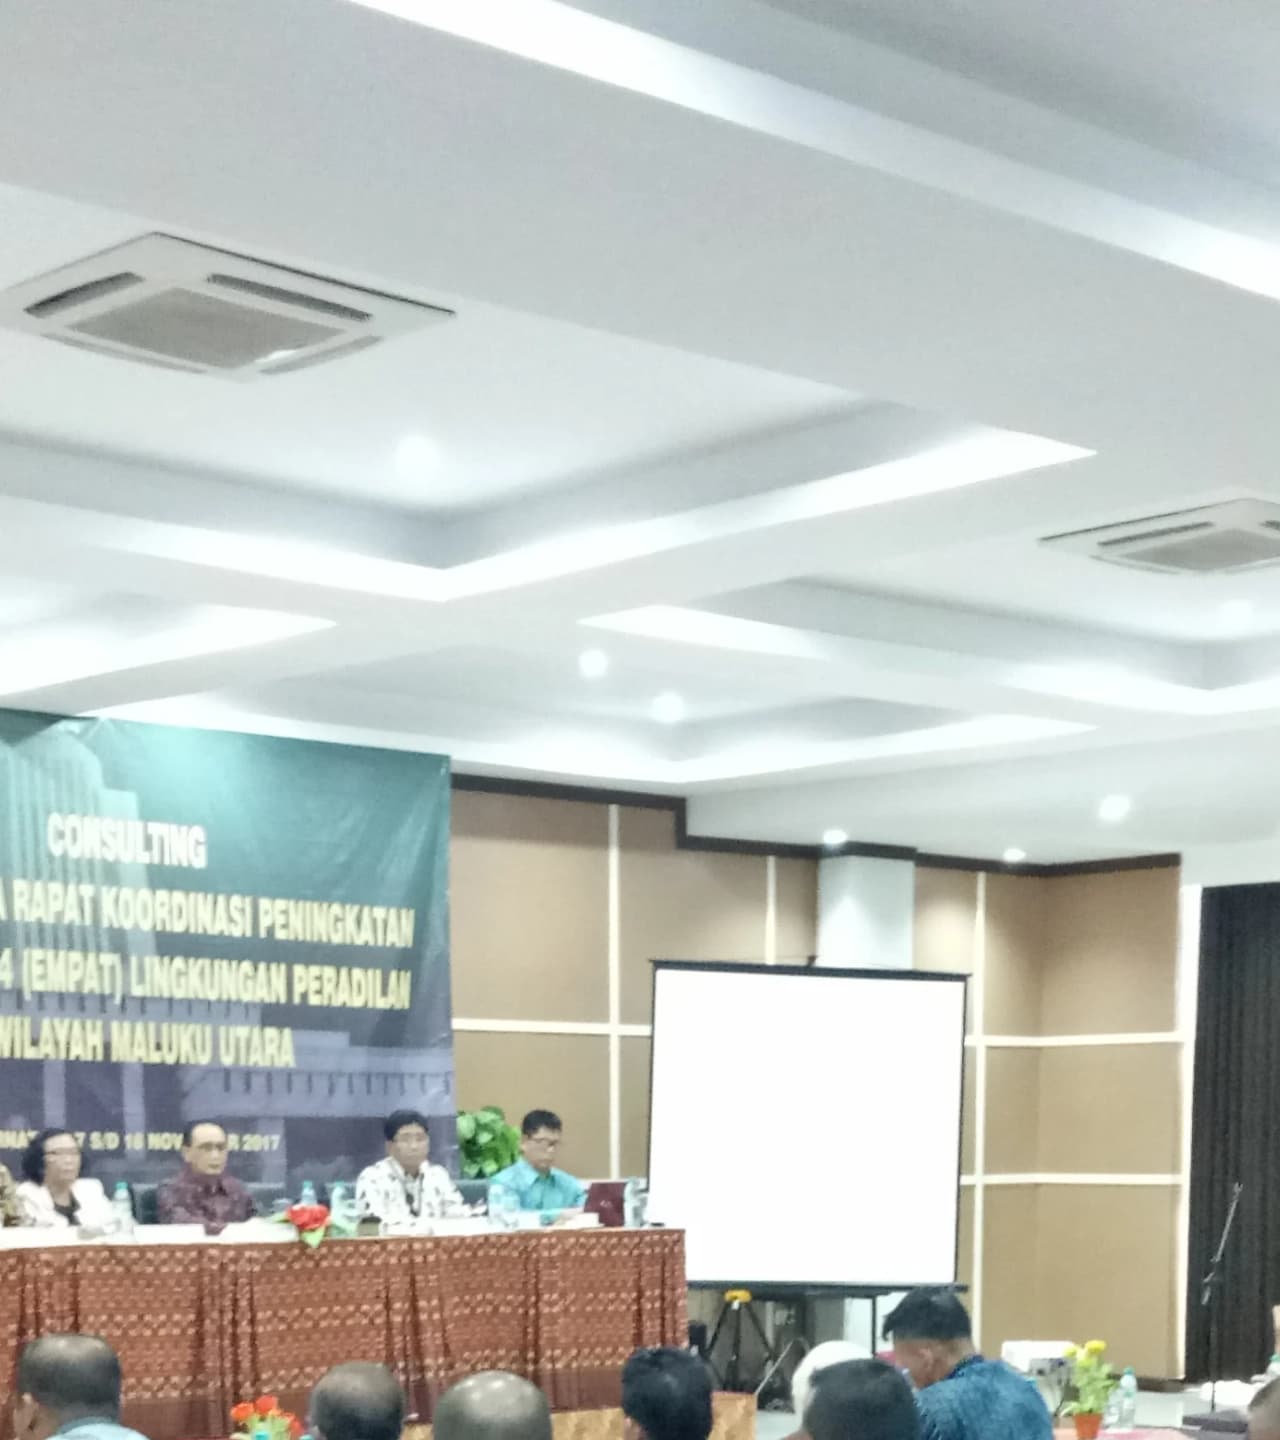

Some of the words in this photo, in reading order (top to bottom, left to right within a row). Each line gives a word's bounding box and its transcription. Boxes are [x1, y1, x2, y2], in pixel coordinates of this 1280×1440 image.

[48, 812, 207, 869] CONSULTING
[13, 878, 96, 926] RAPAT
[101, 886, 253, 937] KOORDINASI
[259, 898, 415, 948] PENINGKATAN
[23, 948, 122, 1004] (EMPAT)
[129, 954, 288, 1004] LINGKUNGAN
[293, 964, 412, 1010] PERADILAN
[111, 1020, 212, 1065] MALUKU
[219, 1025, 296, 1068] UTARA
[241, 1132, 280, 1151] 2017
